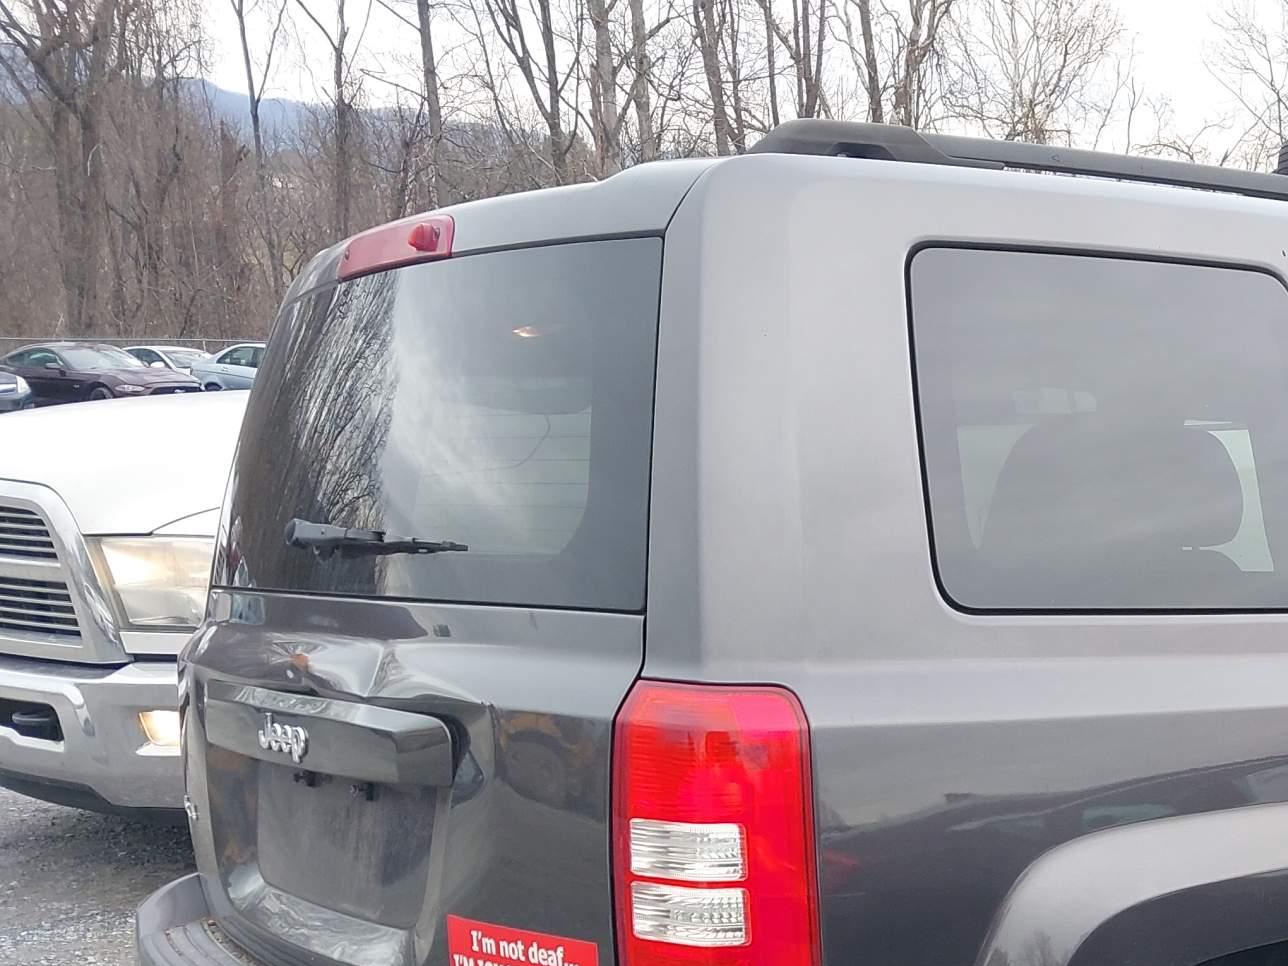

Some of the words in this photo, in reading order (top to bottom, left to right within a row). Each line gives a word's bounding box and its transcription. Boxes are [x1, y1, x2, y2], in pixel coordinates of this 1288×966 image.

[258, 711, 308, 764] Jeep
[470, 929, 496, 956] I'm
[499, 940, 526, 962] not
